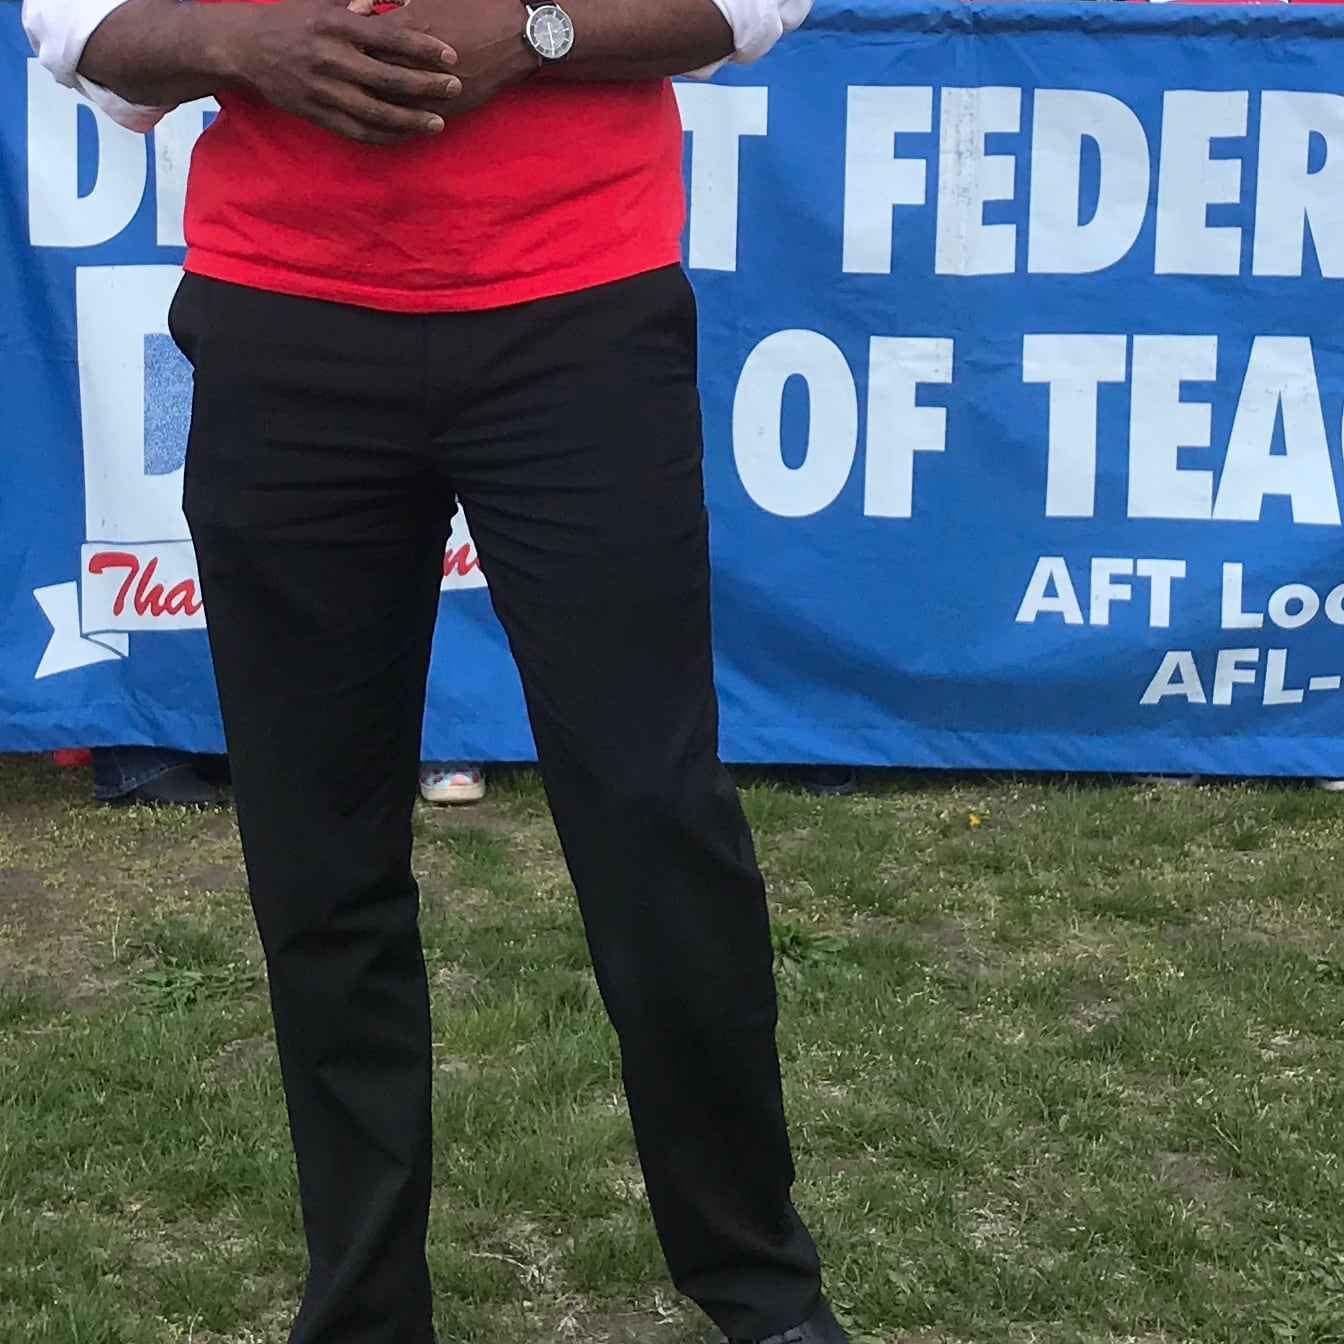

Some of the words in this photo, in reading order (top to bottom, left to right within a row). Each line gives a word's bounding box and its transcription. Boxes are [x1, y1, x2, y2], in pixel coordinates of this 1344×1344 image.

[733, 328, 954, 518] OF
[88, 551, 204, 617] Tha
[1015, 556, 1187, 629] AFT
